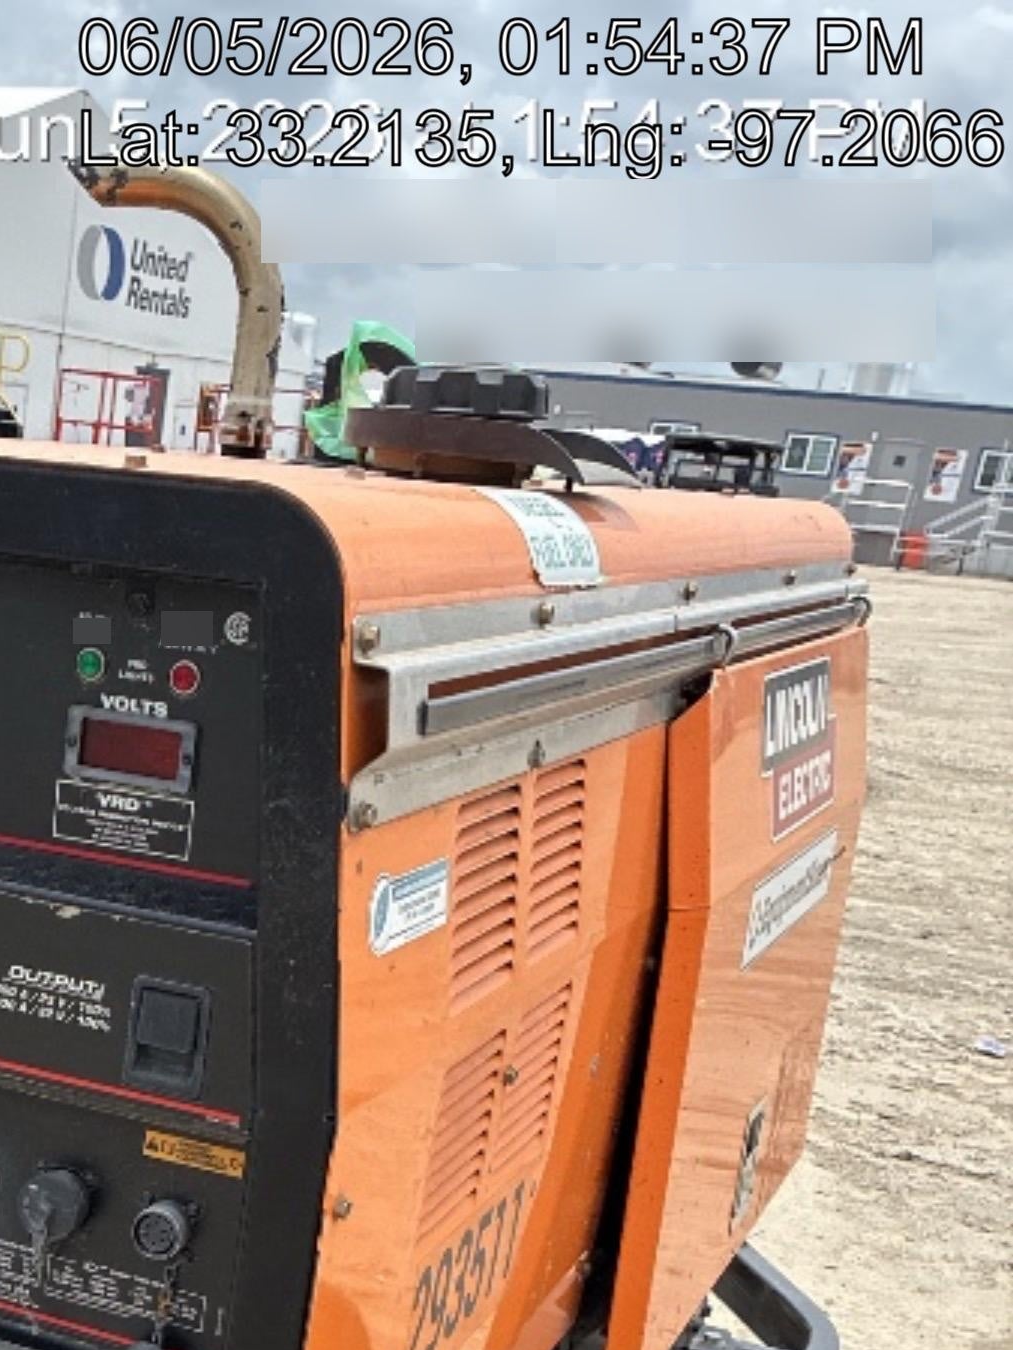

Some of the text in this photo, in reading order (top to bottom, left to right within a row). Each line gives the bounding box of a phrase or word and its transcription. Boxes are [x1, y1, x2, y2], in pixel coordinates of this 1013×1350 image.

[131, 237, 192, 282] United
[126, 276, 191, 318] Rentals
[100, 692, 168, 718] VOLTS
[765, 673, 829, 757] LINCOLN
